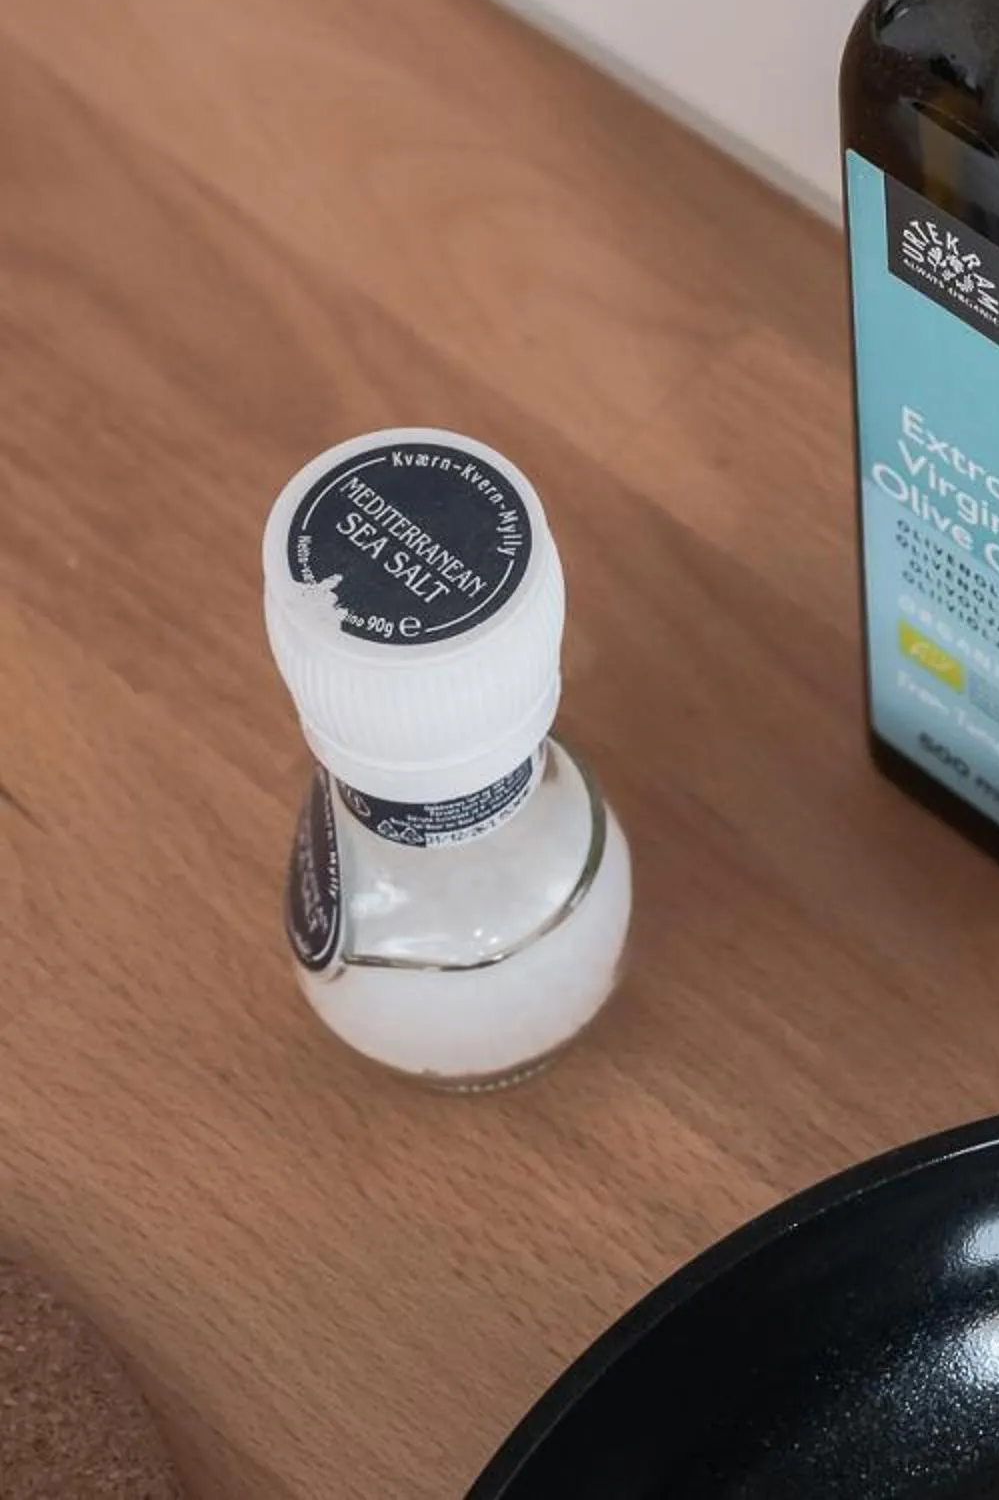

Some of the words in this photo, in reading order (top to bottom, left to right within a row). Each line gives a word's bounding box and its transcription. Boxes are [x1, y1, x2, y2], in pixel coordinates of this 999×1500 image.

[339, 476, 488, 599] MEDITERRANEAN
[872, 463, 974, 552] Olive
[336, 512, 387, 560] SEA
[384, 550, 451, 604] SALT
